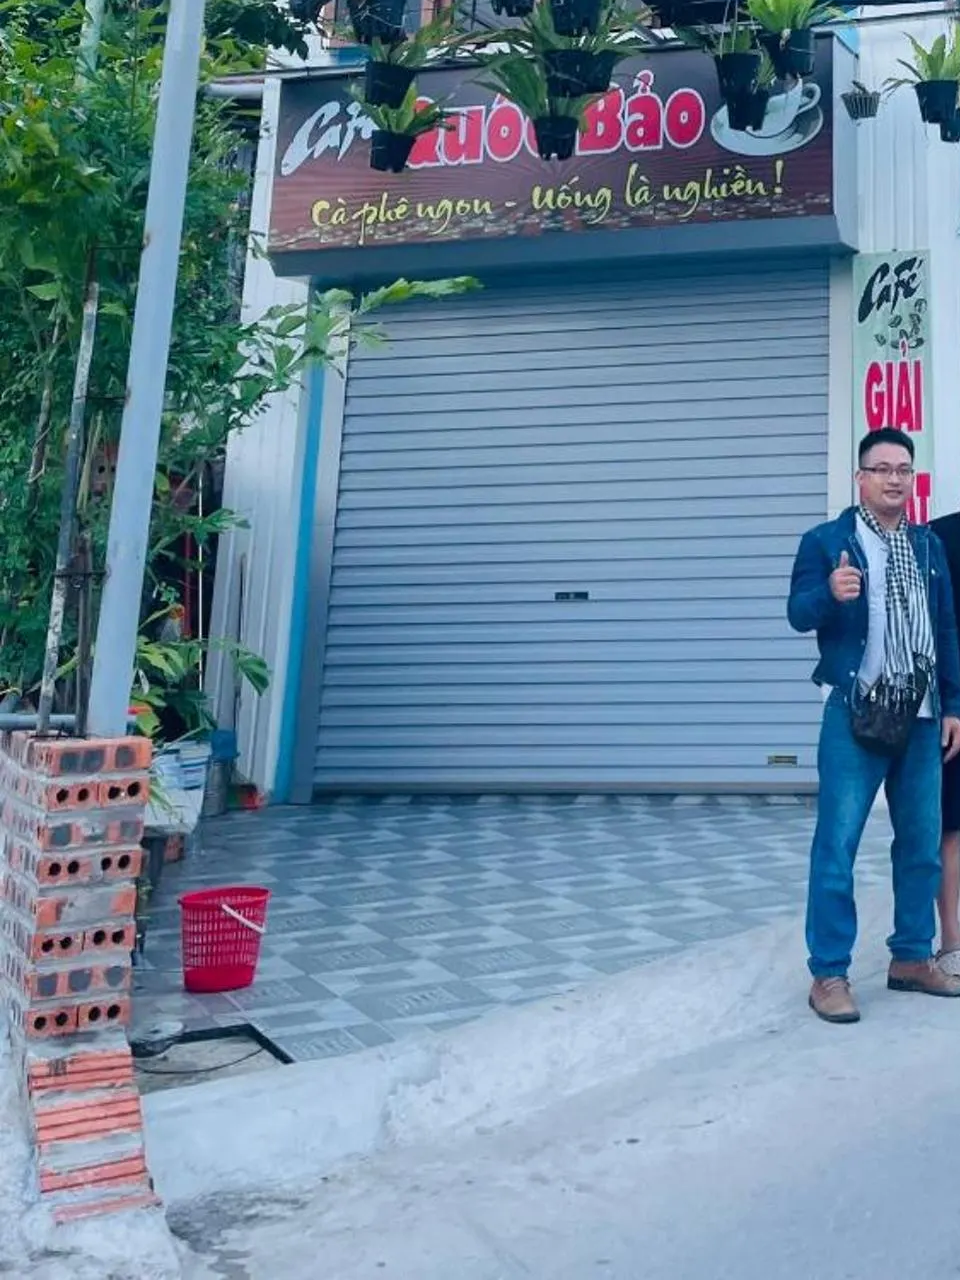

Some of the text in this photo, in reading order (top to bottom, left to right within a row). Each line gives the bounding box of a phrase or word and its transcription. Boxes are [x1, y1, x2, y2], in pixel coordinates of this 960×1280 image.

[575, 70, 705, 157] Bảo
[312, 196, 349, 227] Cà
[352, 191, 411, 246] phê
[416, 198, 494, 236] ngon
[625, 162, 656, 208] là
[864, 338, 924, 433] GIẢI
